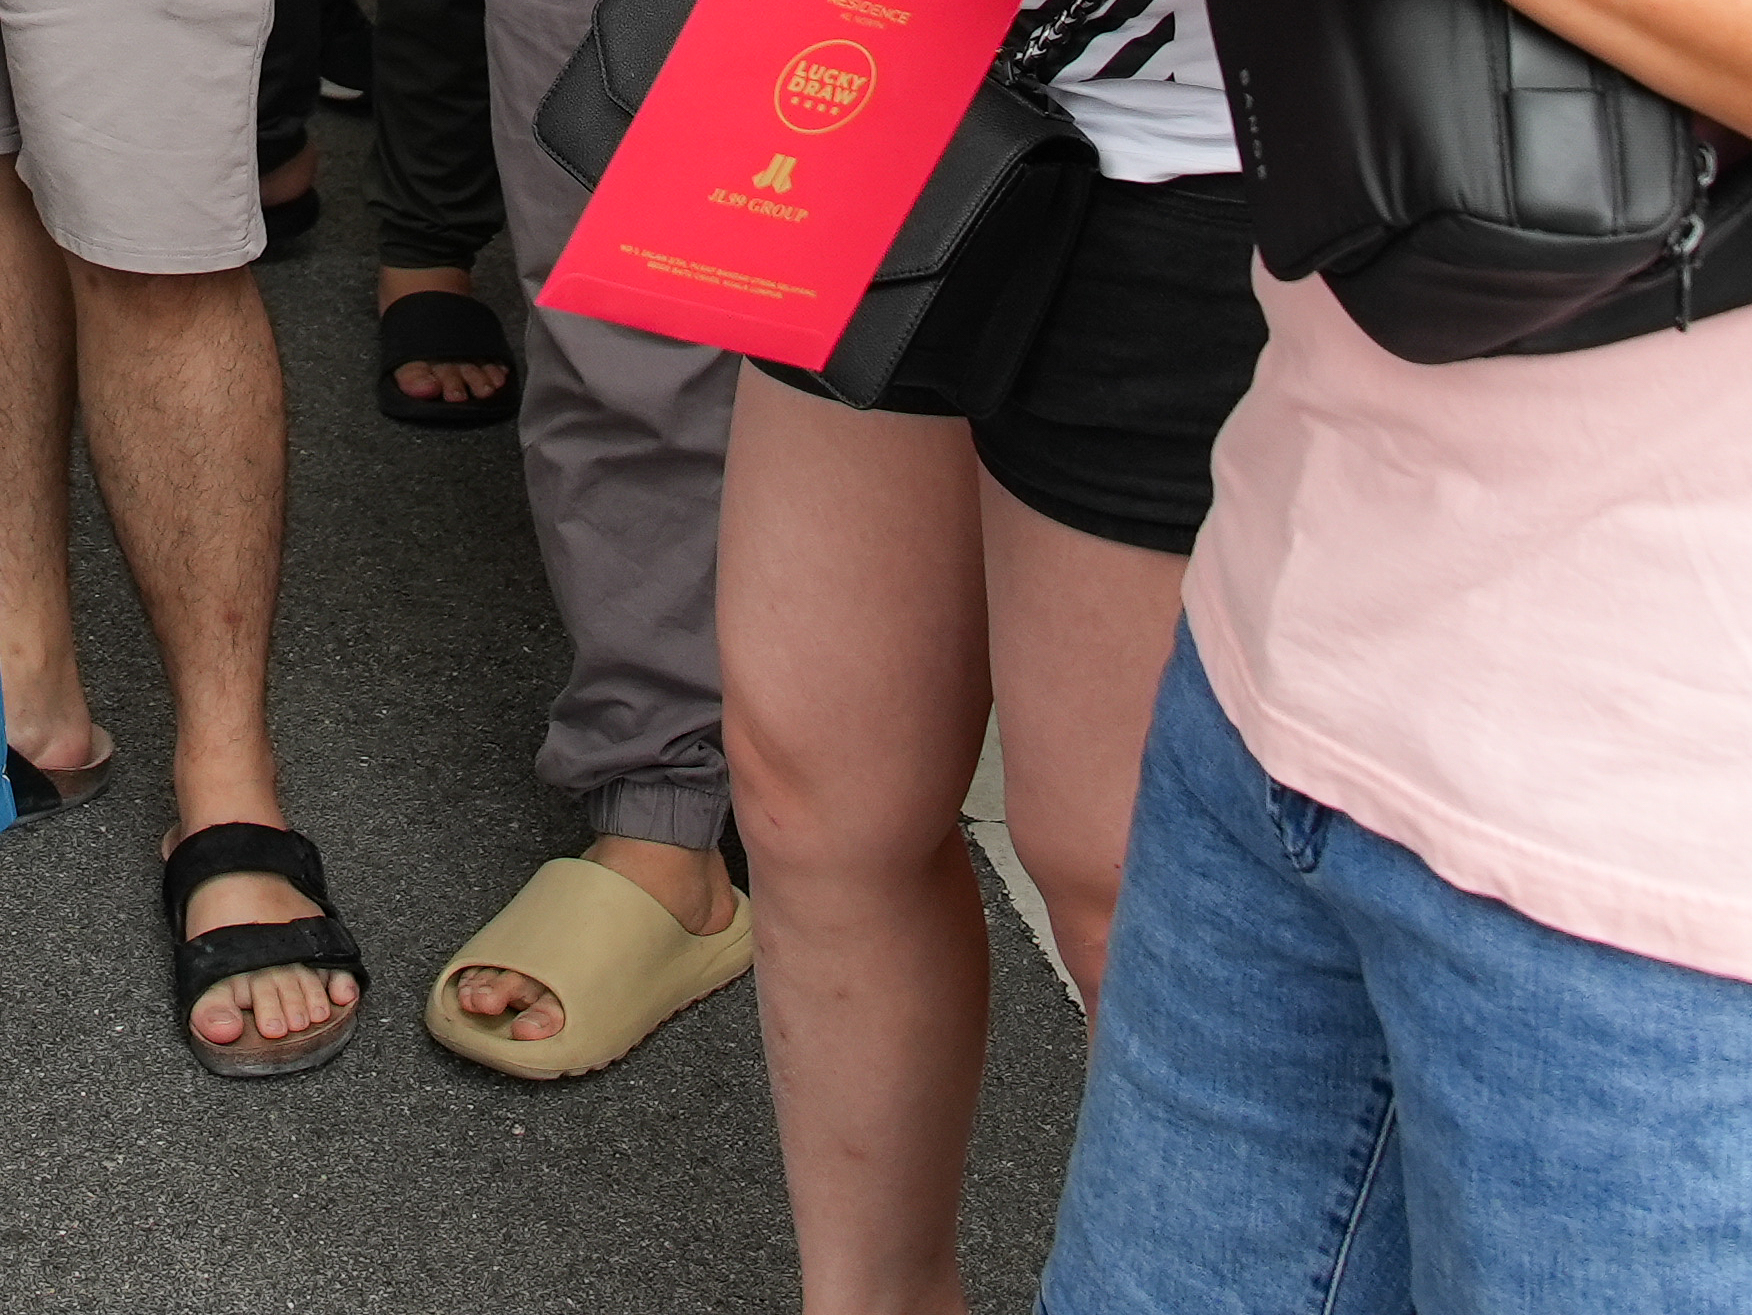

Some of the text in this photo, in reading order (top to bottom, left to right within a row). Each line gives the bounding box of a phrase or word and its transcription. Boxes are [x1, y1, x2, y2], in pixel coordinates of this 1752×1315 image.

[787, 74, 858, 105] DRAW
[795, 60, 870, 91] LUCKY
[748, 197, 809, 223] GROUP
